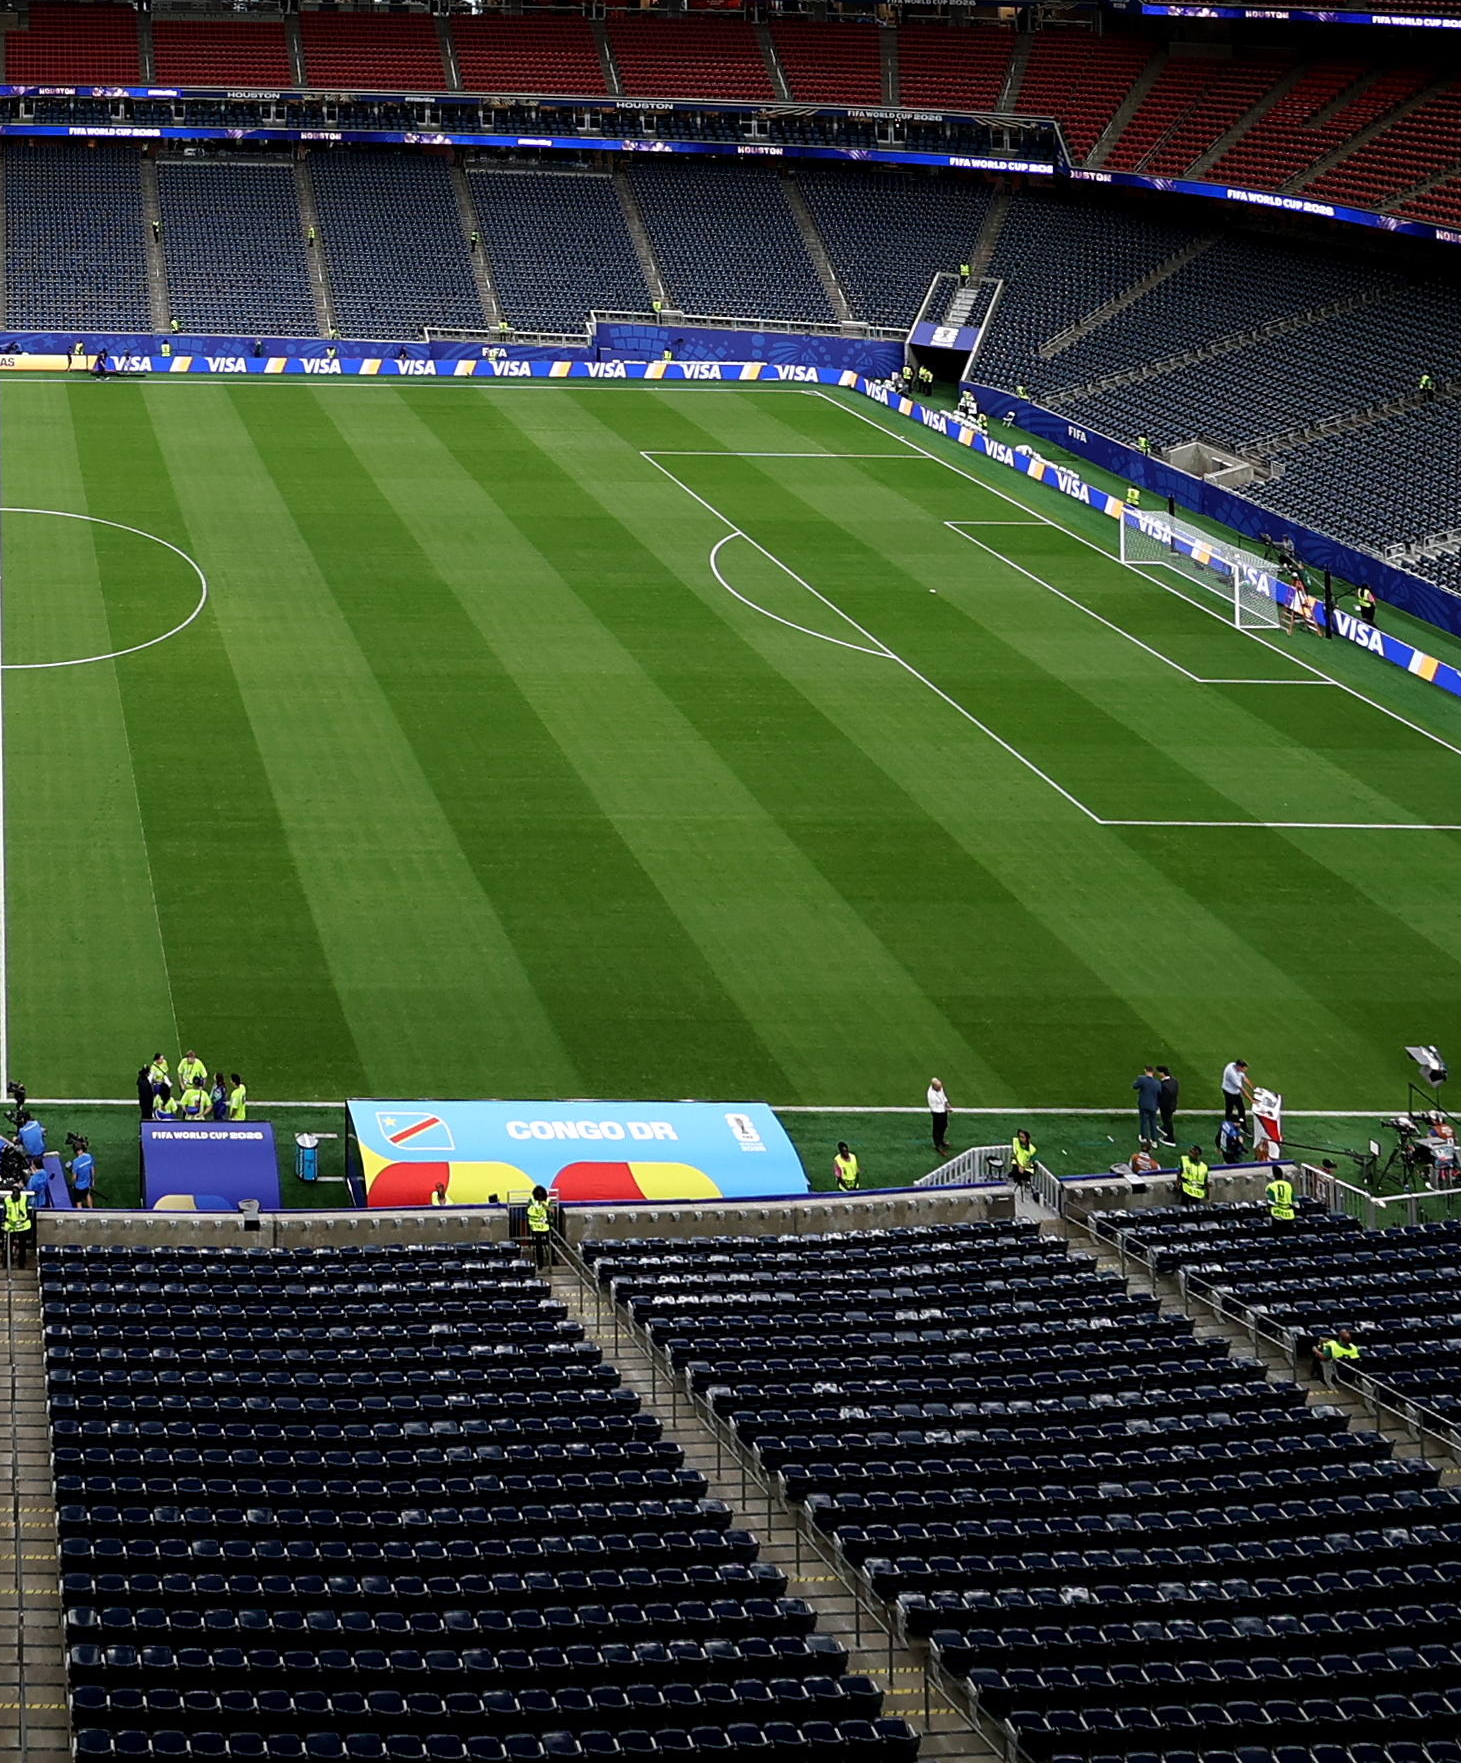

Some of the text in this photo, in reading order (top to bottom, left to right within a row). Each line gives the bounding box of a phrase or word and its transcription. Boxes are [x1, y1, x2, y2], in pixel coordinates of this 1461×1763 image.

[1372, 15, 1393, 25] FIFA
[1393, 16, 1423, 27] WORLD
[1424, 18, 1442, 28] CUP
[738, 146, 783, 155] HOUSTON
[949, 157, 1053, 174] FIFA WORLD CUP 202
[1227, 189, 1334, 216] FIFA WORLD CUP 2026
[482, 347, 508, 358] FFA
[204, 357, 246, 373] VISA
[299, 358, 341, 374] VISA
[394, 360, 436, 375] VISA
[489, 361, 531, 376] VISA
[584, 362, 626, 377] VISA
[680, 363, 721, 379] VISA
[773, 365, 818, 382] VISA
[864, 379, 889, 404] VISA
[920, 406, 947, 434] VISA
[1068, 426, 1087, 444] FIFA
[983, 437, 1014, 468] VISA
[1055, 470, 1089, 504] VISA
[1333, 608, 1385, 657] VISA
[152, 1132, 174, 1140] FIFA
[175, 1132, 209, 1140] WORLD
[209, 1132, 229, 1140] CUP
[506, 1121, 679, 1141] CONGO DR
